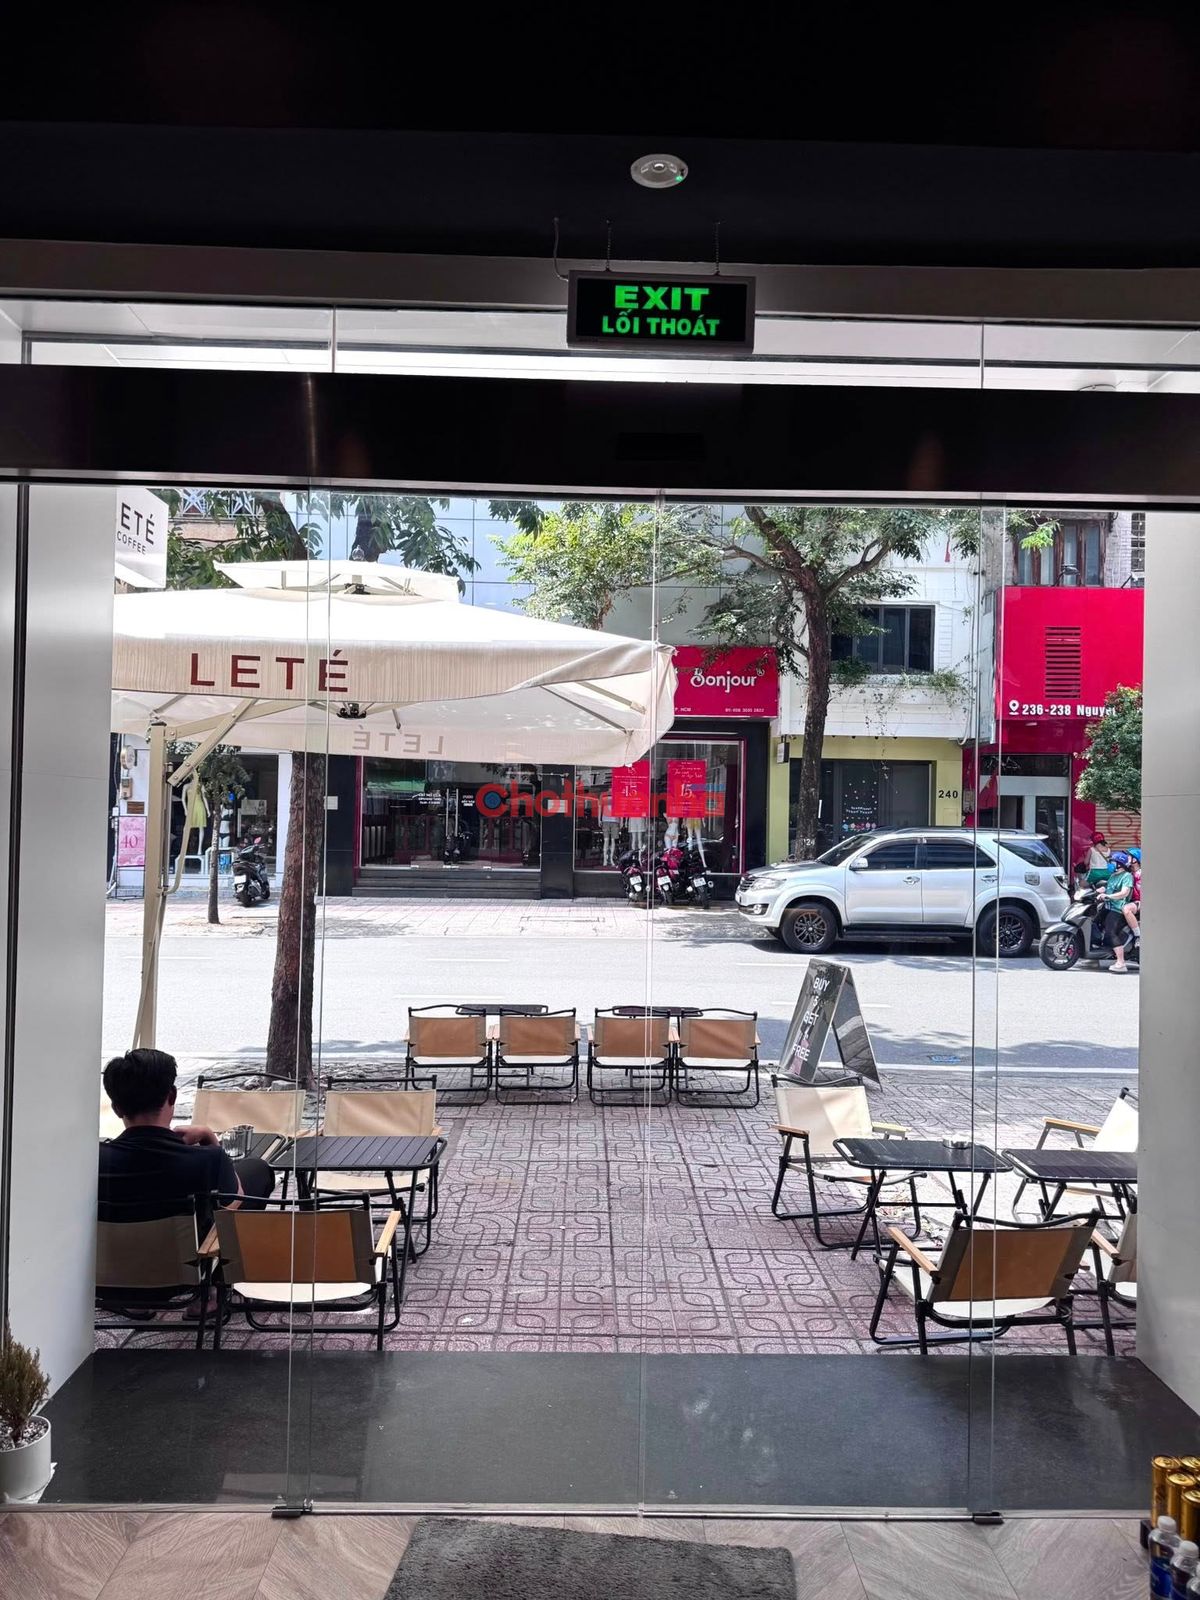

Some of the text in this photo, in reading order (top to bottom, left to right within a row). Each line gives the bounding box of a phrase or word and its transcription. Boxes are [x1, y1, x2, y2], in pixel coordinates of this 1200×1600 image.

[615, 285, 709, 310] EXIT
[602, 309, 720, 336] LỐI THOÁT
[121, 502, 155, 545] ETÉ
[117, 530, 146, 555] COFFEE
[190, 649, 349, 693] LETÉ
[690, 667, 757, 693] Bonjour
[1022, 704, 1072, 716] 236-238
[938, 790, 959, 799] 240
[813, 977, 830, 992] BUY
[803, 1009, 820, 1026] GET
[792, 1043, 811, 1062] FREE
